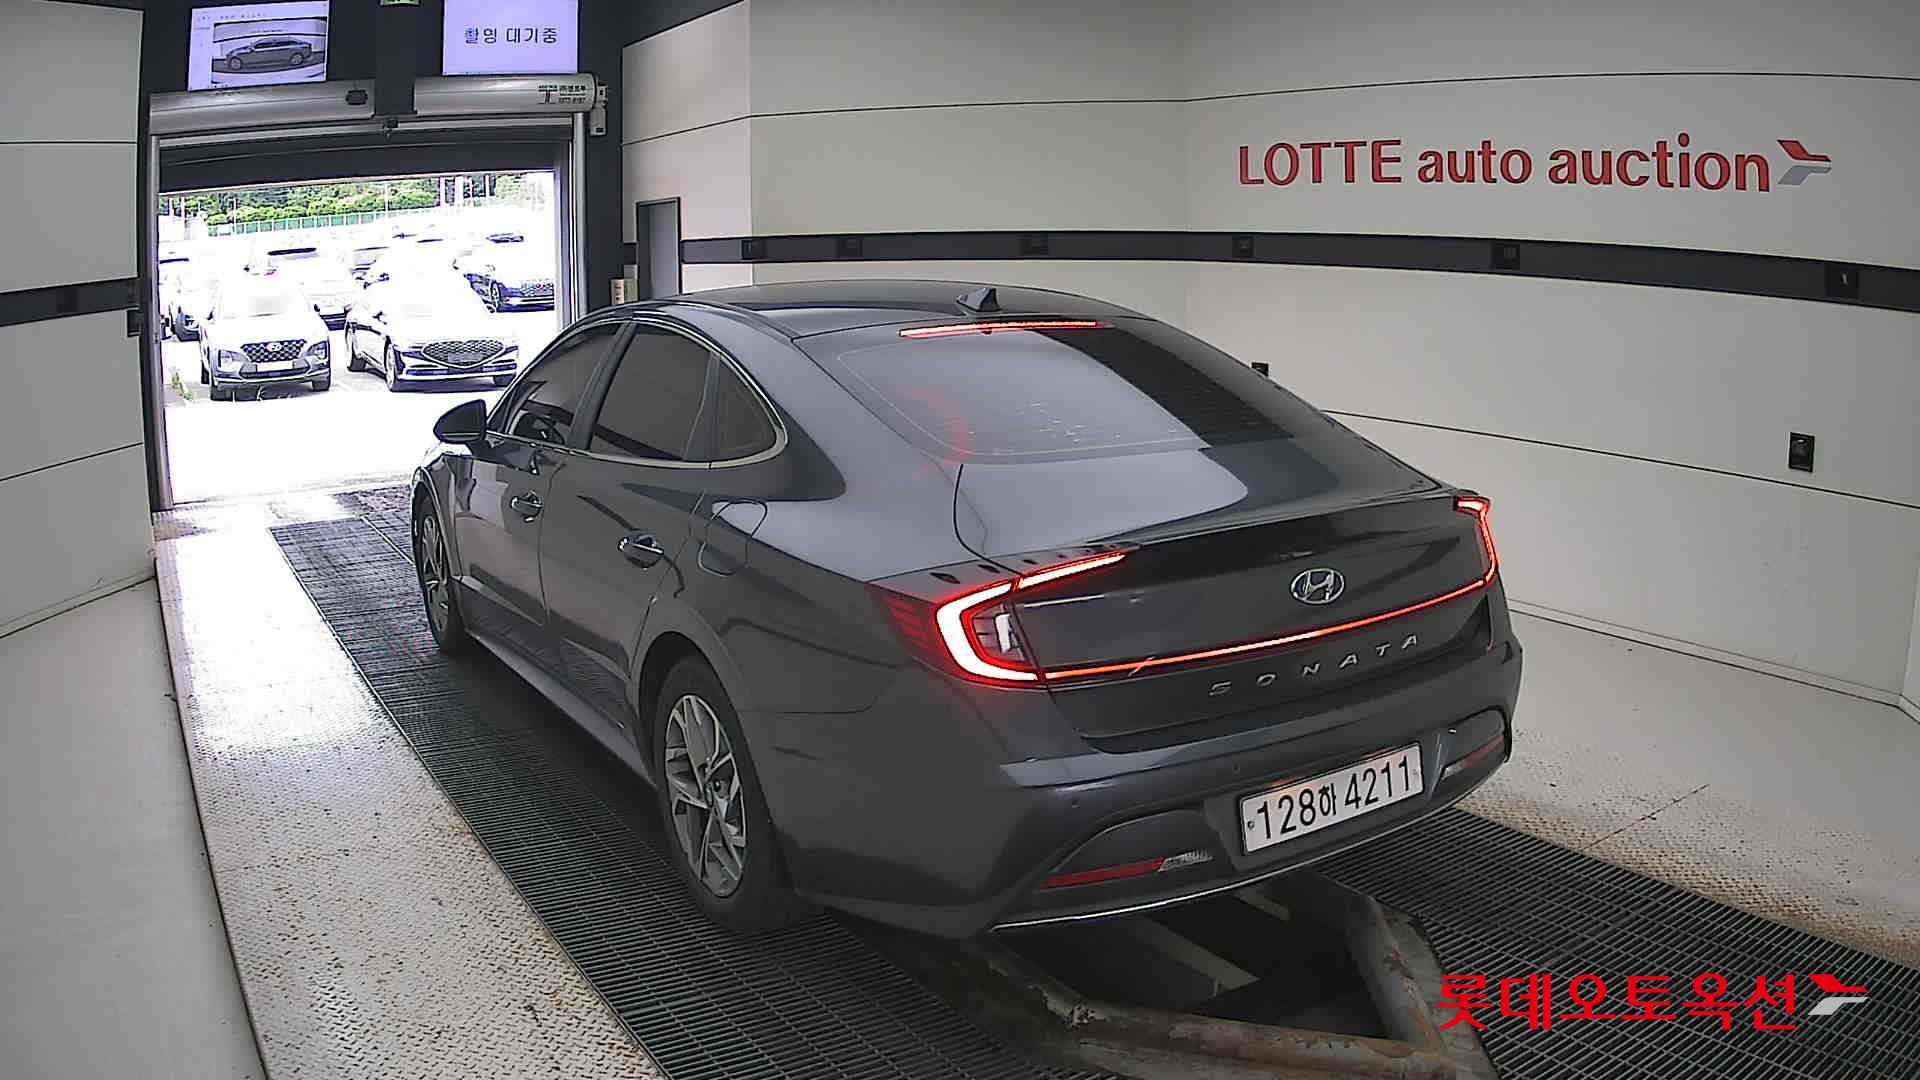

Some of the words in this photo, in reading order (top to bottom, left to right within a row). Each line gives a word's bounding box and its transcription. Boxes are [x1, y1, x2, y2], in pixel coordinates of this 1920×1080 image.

[506, 27, 557, 44] 대기중
[1239, 139, 1402, 186] LOTTE
[1417, 139, 1532, 184] auto
[1548, 132, 1770, 193] auction
[1208, 634, 1418, 696] SONATA
[1257, 783, 1337, 839] 128하
[1344, 755, 1410, 809] 4211
